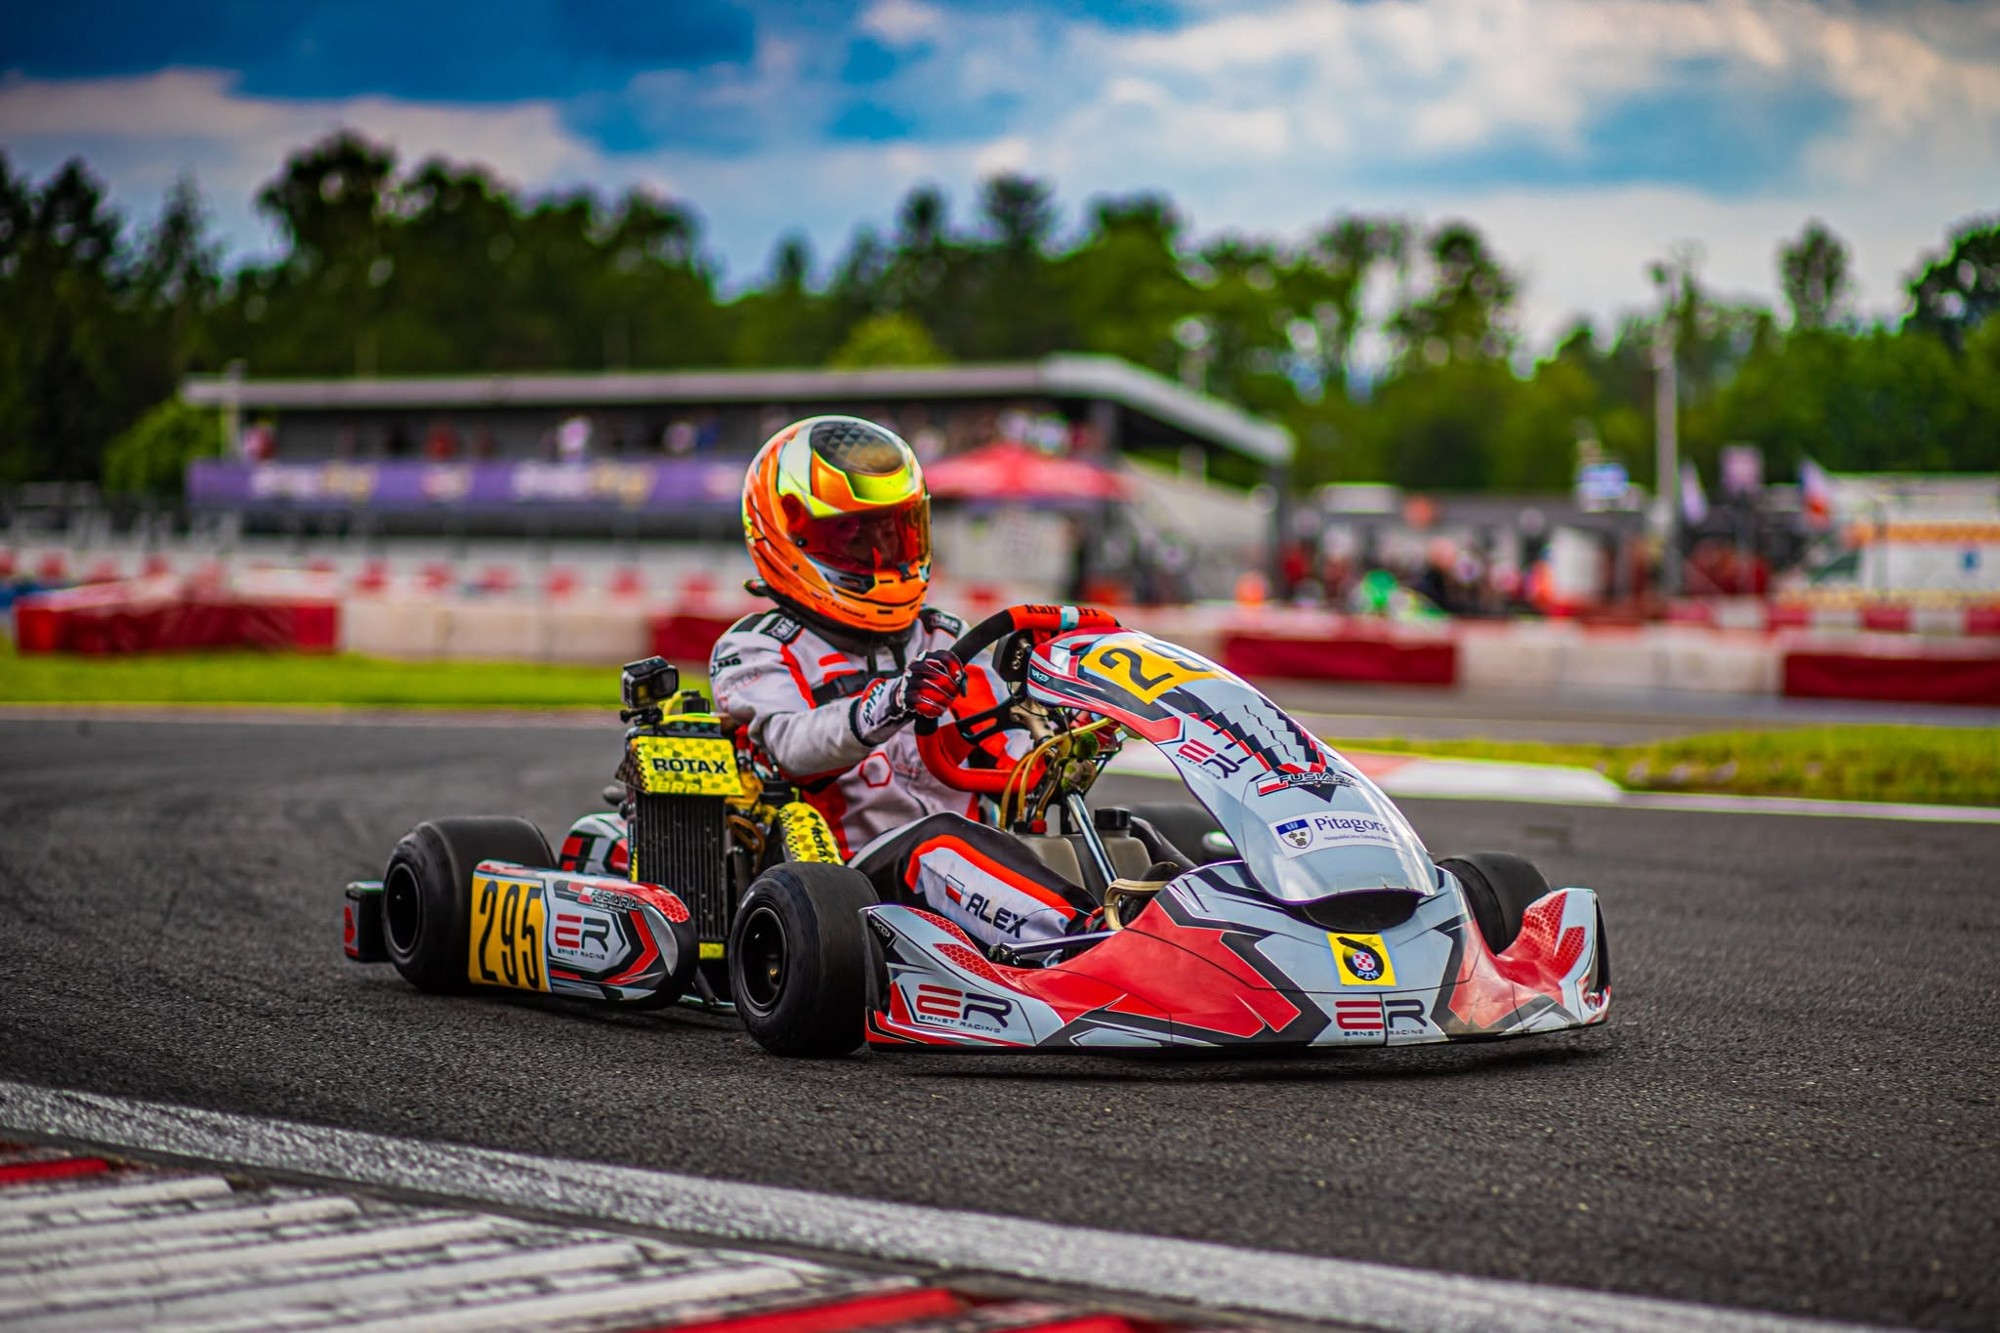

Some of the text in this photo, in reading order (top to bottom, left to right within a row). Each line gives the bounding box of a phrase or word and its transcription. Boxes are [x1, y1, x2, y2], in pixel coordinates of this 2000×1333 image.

[651, 757, 729, 775] ROTAX
[965, 892, 1029, 939] ALEX
[478, 880, 543, 990] 295
[555, 913, 610, 953] ER
[1357, 969, 1380, 980] PZM
[916, 983, 1012, 1028] ER
[1334, 999, 1428, 1030] ER
[919, 1014, 1001, 1034] ERNST RACING
[1388, 1028, 1425, 1036] RACING
